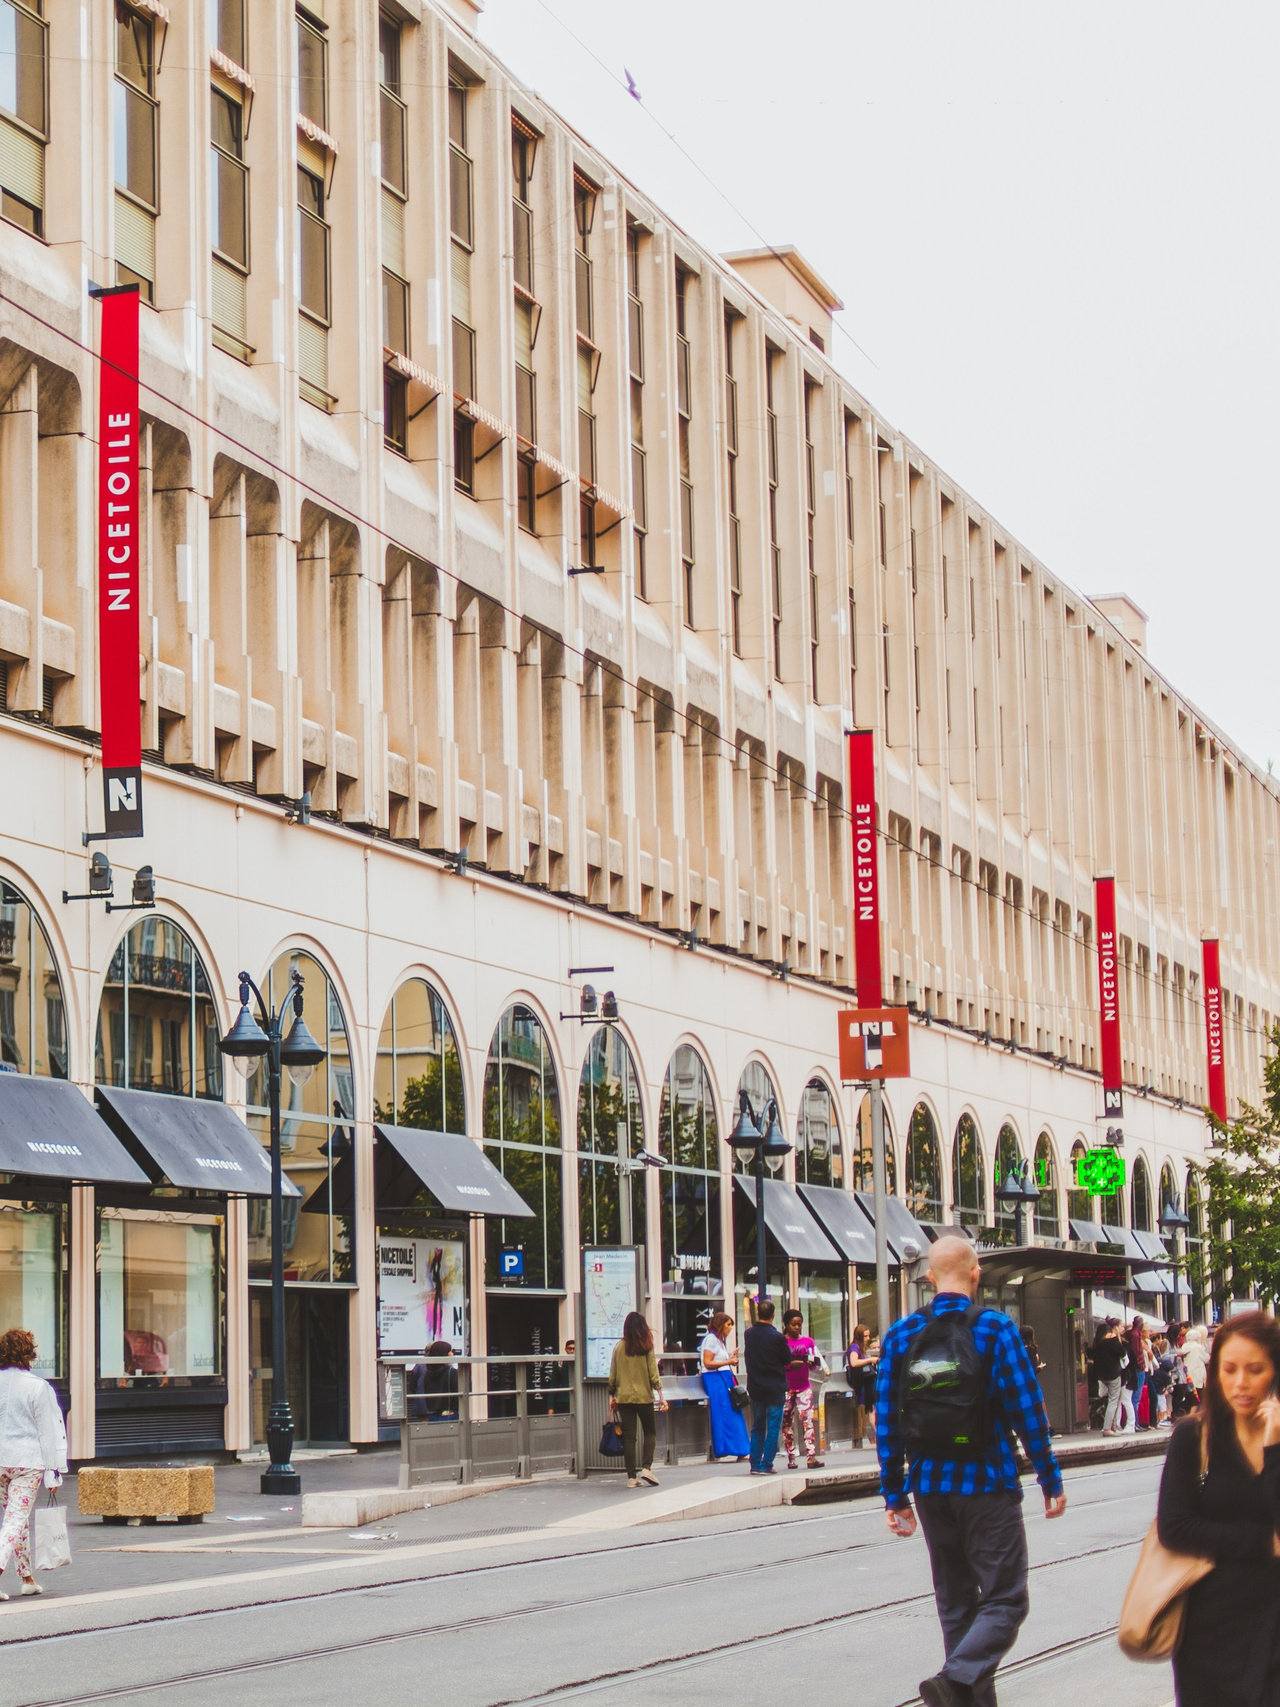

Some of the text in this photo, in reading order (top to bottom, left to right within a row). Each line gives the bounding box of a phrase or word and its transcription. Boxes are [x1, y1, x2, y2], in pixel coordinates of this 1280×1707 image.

[108, 412, 131, 611] NICETOILE
[109, 777, 137, 812] N
[856, 803, 874, 921] NICETOILE
[1102, 931, 1116, 1022] NICETOILE
[1208, 987, 1222, 1066] NICETOILE
[1106, 1091, 1121, 1108] N
[26, 1141, 82, 1156] NICETOILE
[195, 1157, 242, 1171] NICETOILE
[380, 1247, 413, 1265] NICETOILE
[505, 1255, 519, 1272] P
[595, 1264, 601, 1272] 1
[453, 1306, 463, 1336] N
[532, 1360, 543, 1400] prking
